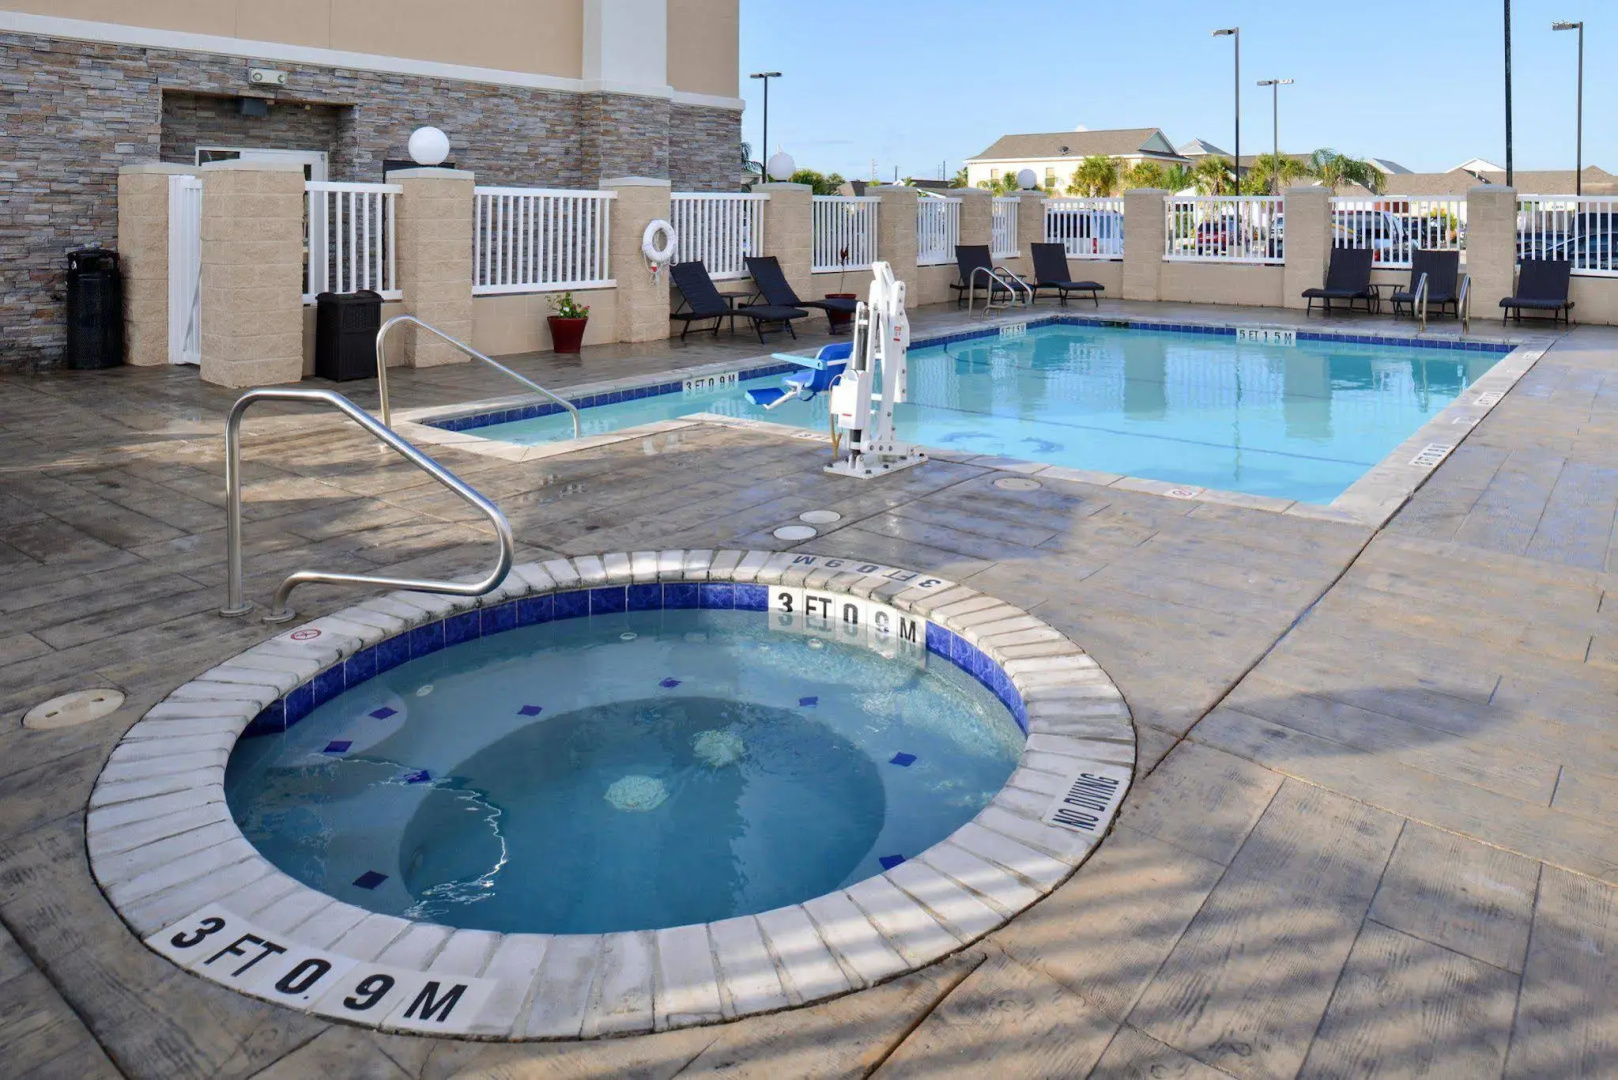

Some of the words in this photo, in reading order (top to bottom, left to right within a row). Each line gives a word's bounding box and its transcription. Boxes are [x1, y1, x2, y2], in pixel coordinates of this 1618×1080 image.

[1063, 773, 1119, 812] DIVING
[1052, 808, 1099, 831] NO
[170, 917, 226, 949] 3
[203, 933, 287, 977] FT
[403, 981, 468, 1023] M
